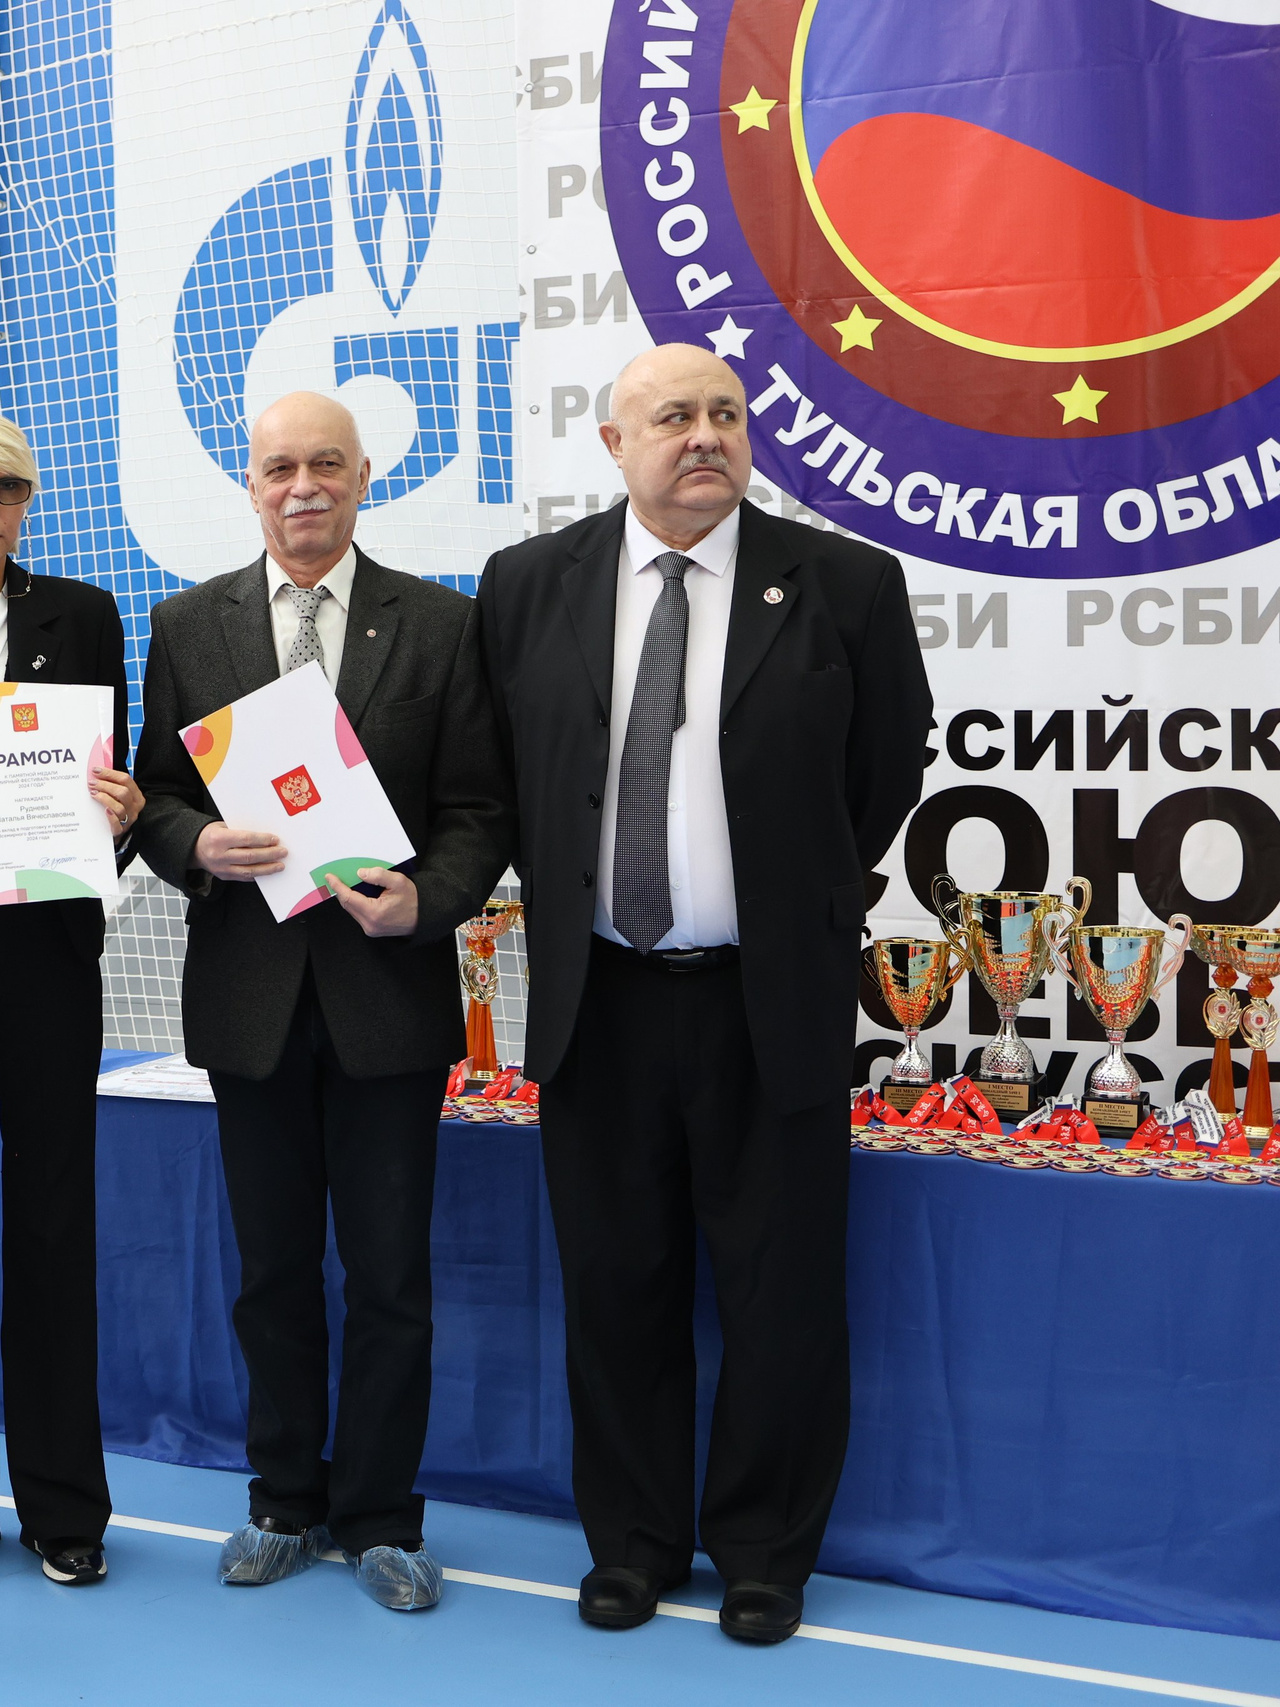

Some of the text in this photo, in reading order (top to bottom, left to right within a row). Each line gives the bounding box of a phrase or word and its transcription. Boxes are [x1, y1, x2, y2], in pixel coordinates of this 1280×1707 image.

[748, 363, 1079, 549] ТУЛЬСКАЯ
[923, 694, 1280, 773] СИЙСК
[20, 805, 50, 813] Руднева
[26, 811, 75, 820] Вячеславовна
